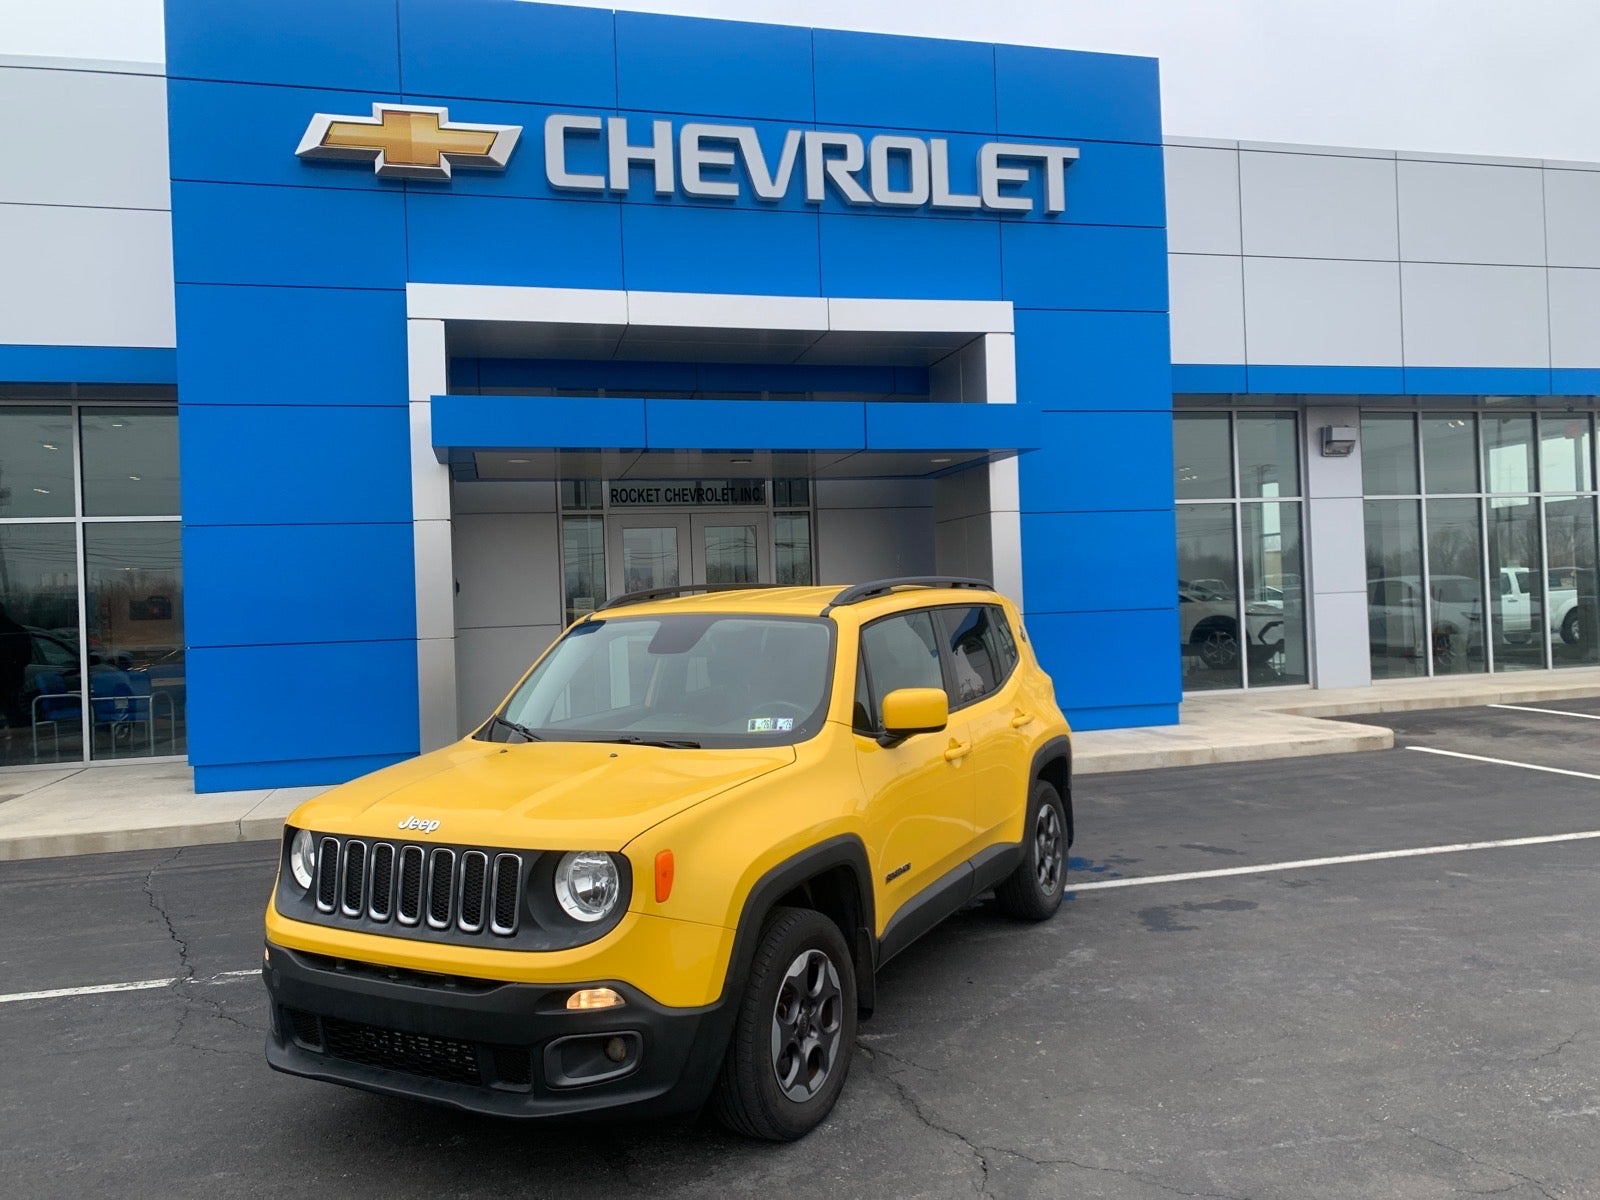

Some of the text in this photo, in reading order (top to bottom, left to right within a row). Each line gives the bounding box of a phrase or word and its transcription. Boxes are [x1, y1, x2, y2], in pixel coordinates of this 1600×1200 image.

[544, 113, 1080, 213] CHEVROLET
[610, 488, 660, 503] ROCKET
[740, 487, 764, 502] INC.
[397, 815, 441, 834] Jeep
